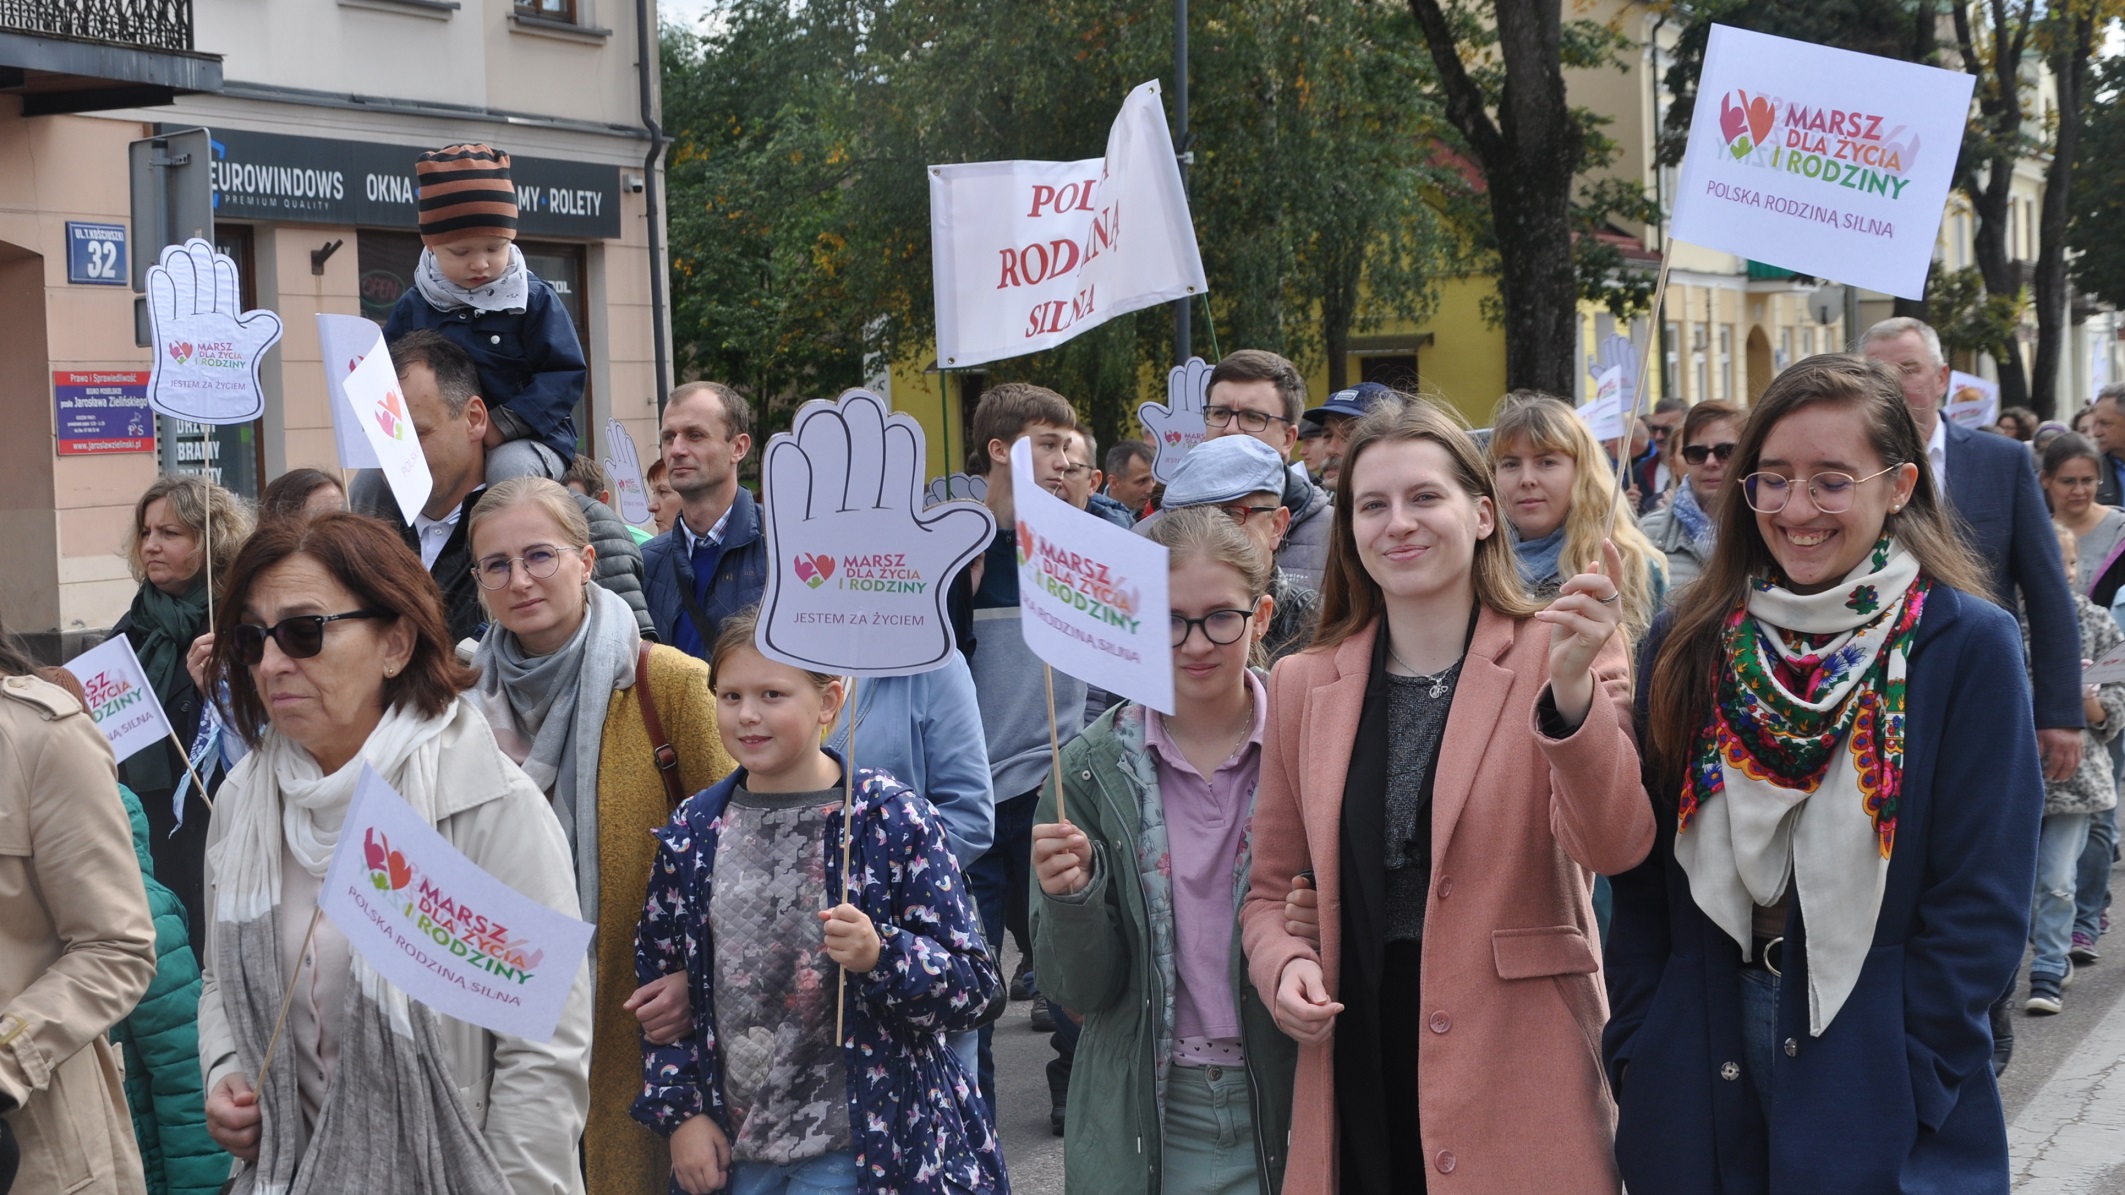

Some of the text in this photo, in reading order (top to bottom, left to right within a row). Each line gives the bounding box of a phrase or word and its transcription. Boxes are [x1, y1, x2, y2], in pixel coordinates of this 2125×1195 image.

[1784, 103, 1884, 141] MARSZ
[1785, 129, 1902, 172] DLA ŻYCIA
[211, 161, 344, 200] EUROWINDOWS
[1772, 145, 1911, 201] I RODZINY
[225, 194, 330, 211] PREMIUM QUALITY
[366, 173, 602, 217] OKNA MY ROLETY
[1706, 180, 1895, 239] POLSKA RODZINĄ SILNA
[87, 240, 117, 278] 32
[1025, 283, 1095, 338] SILNA
[197, 342, 233, 351] MARSZ
[199, 351, 216, 359] DLA
[201, 358, 247, 369] RODZINY
[170, 380, 246, 390] JESTEM ZA ŻYCIEM
[843, 553, 905, 568] MARSZ
[846, 566, 921, 580] DLA ŻYCIA
[1038, 536, 1111, 585] MARSZ
[1042, 557, 1075, 589] DLA
[839, 577, 927, 594] I RODZINY
[793, 611, 924, 626] JESTEM ZA ŻYCIEM
[1046, 575, 1142, 635] RODZINY
[92, 687, 142, 724] DZINY
[121, 711, 154, 734] SILNA
[418, 877, 509, 944] MARSZ
[348, 885, 393, 939] POLSKA
[469, 981, 521, 1007] SILNA
[404, 902, 535, 985] I RODZINY
[418, 896, 526, 969] DLA ŻYCIA
